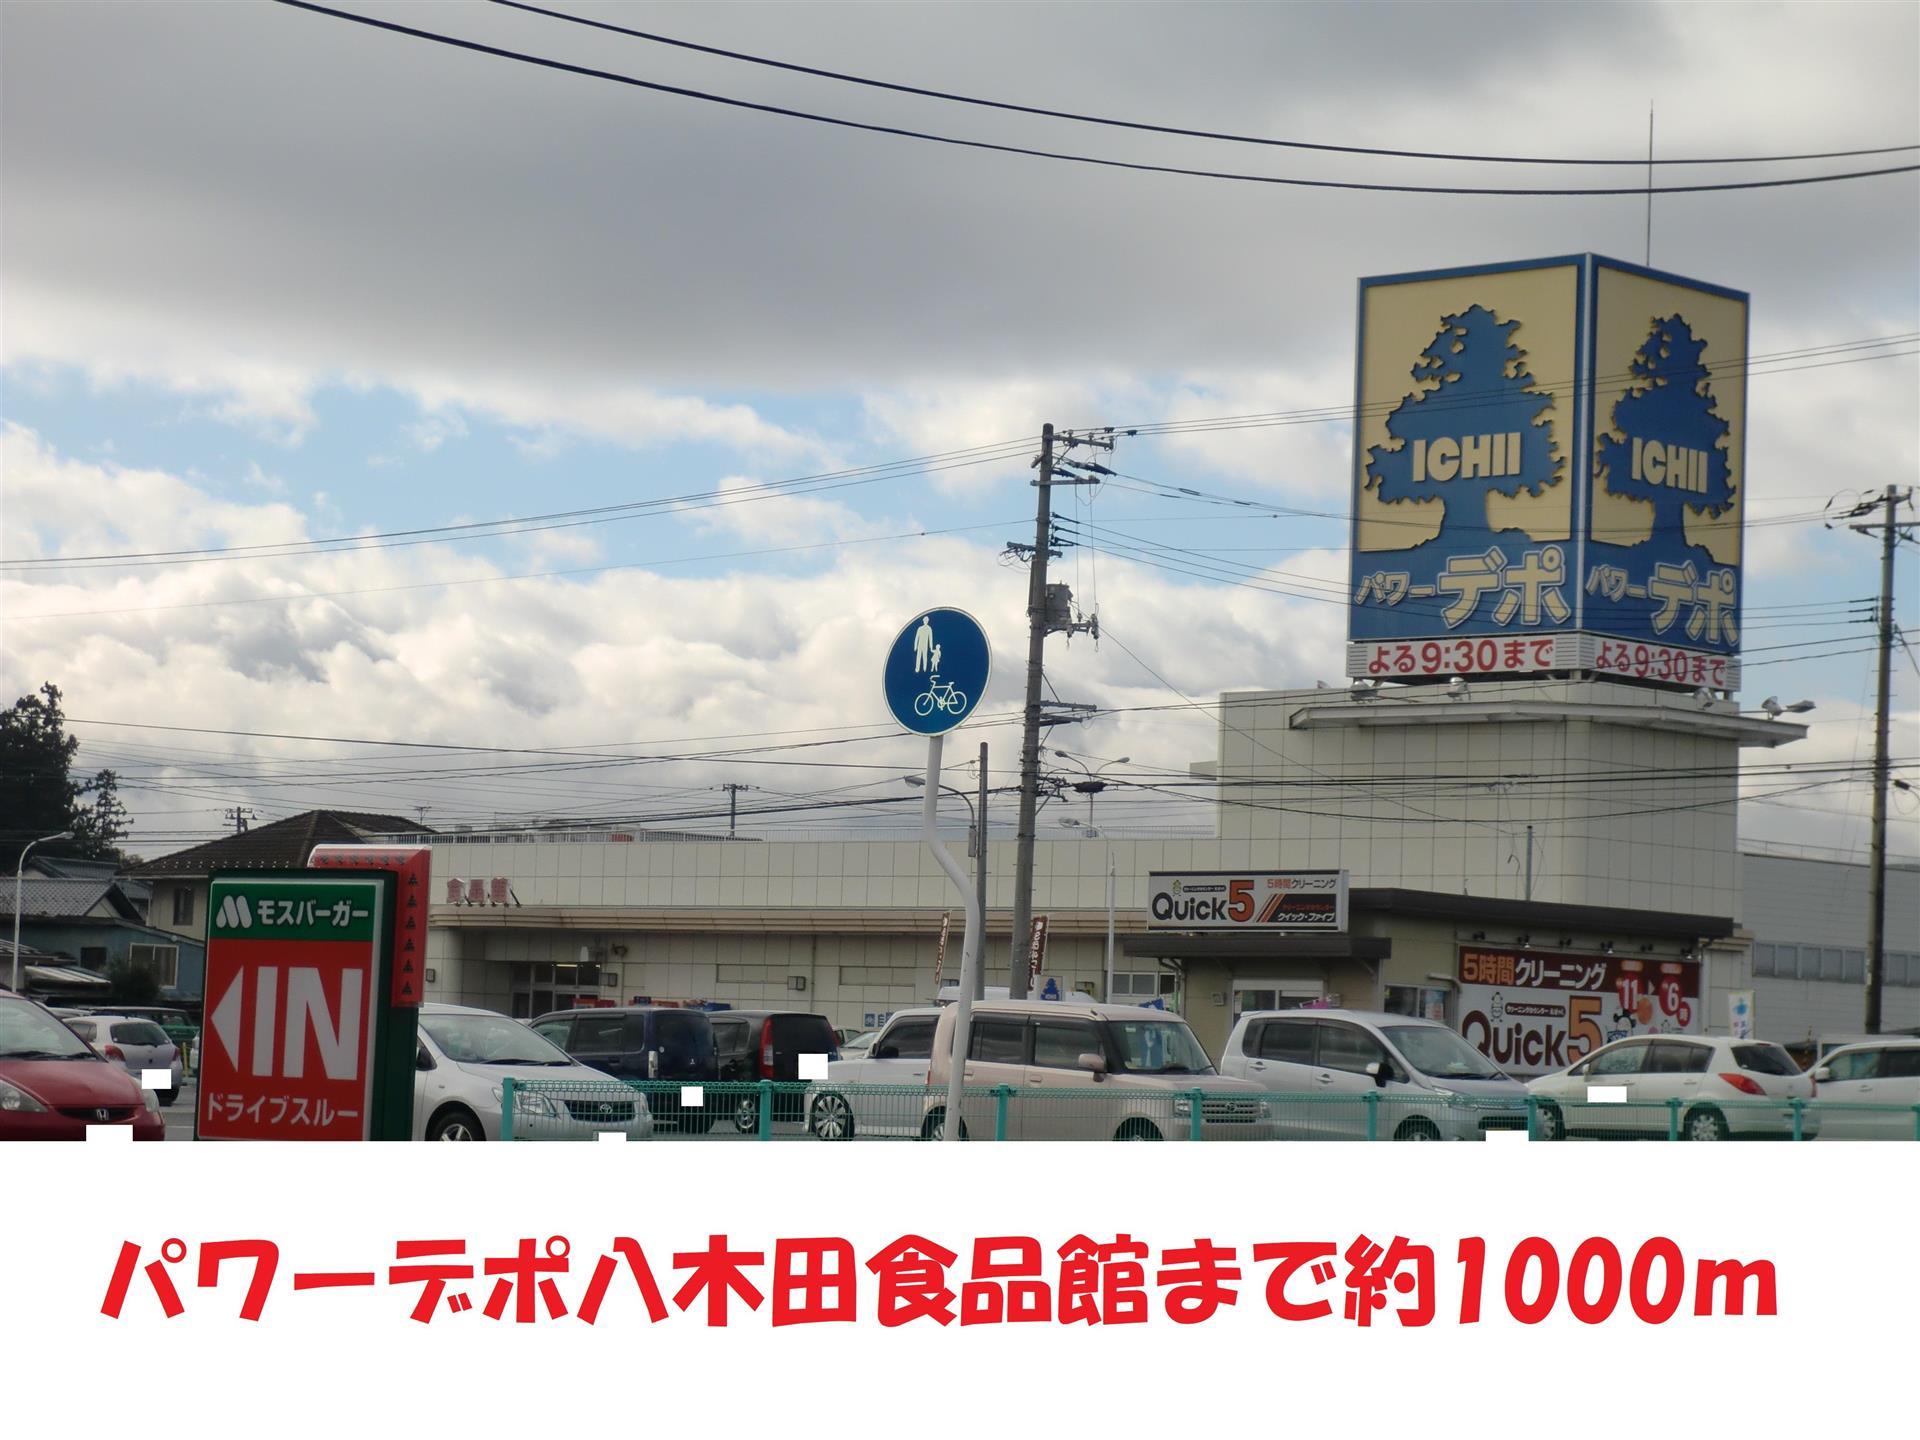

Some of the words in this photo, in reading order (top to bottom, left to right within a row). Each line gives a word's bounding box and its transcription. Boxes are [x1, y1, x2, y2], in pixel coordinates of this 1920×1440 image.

[1413, 432, 1521, 482] ICHII
[1632, 437, 1708, 494] ICHII
[1355, 545, 1572, 629] パワーデポ
[1585, 559, 1740, 648] パワーデポ
[1368, 638, 1554, 676] よる9:30まで
[1596, 641, 1727, 687] よる9:30まで
[257, 899, 369, 927] モスバーガー
[1463, 953, 1607, 990] 5時間クリーニング
[252, 965, 364, 1081] IN
[208, 1092, 358, 1126] ドライブスルー
